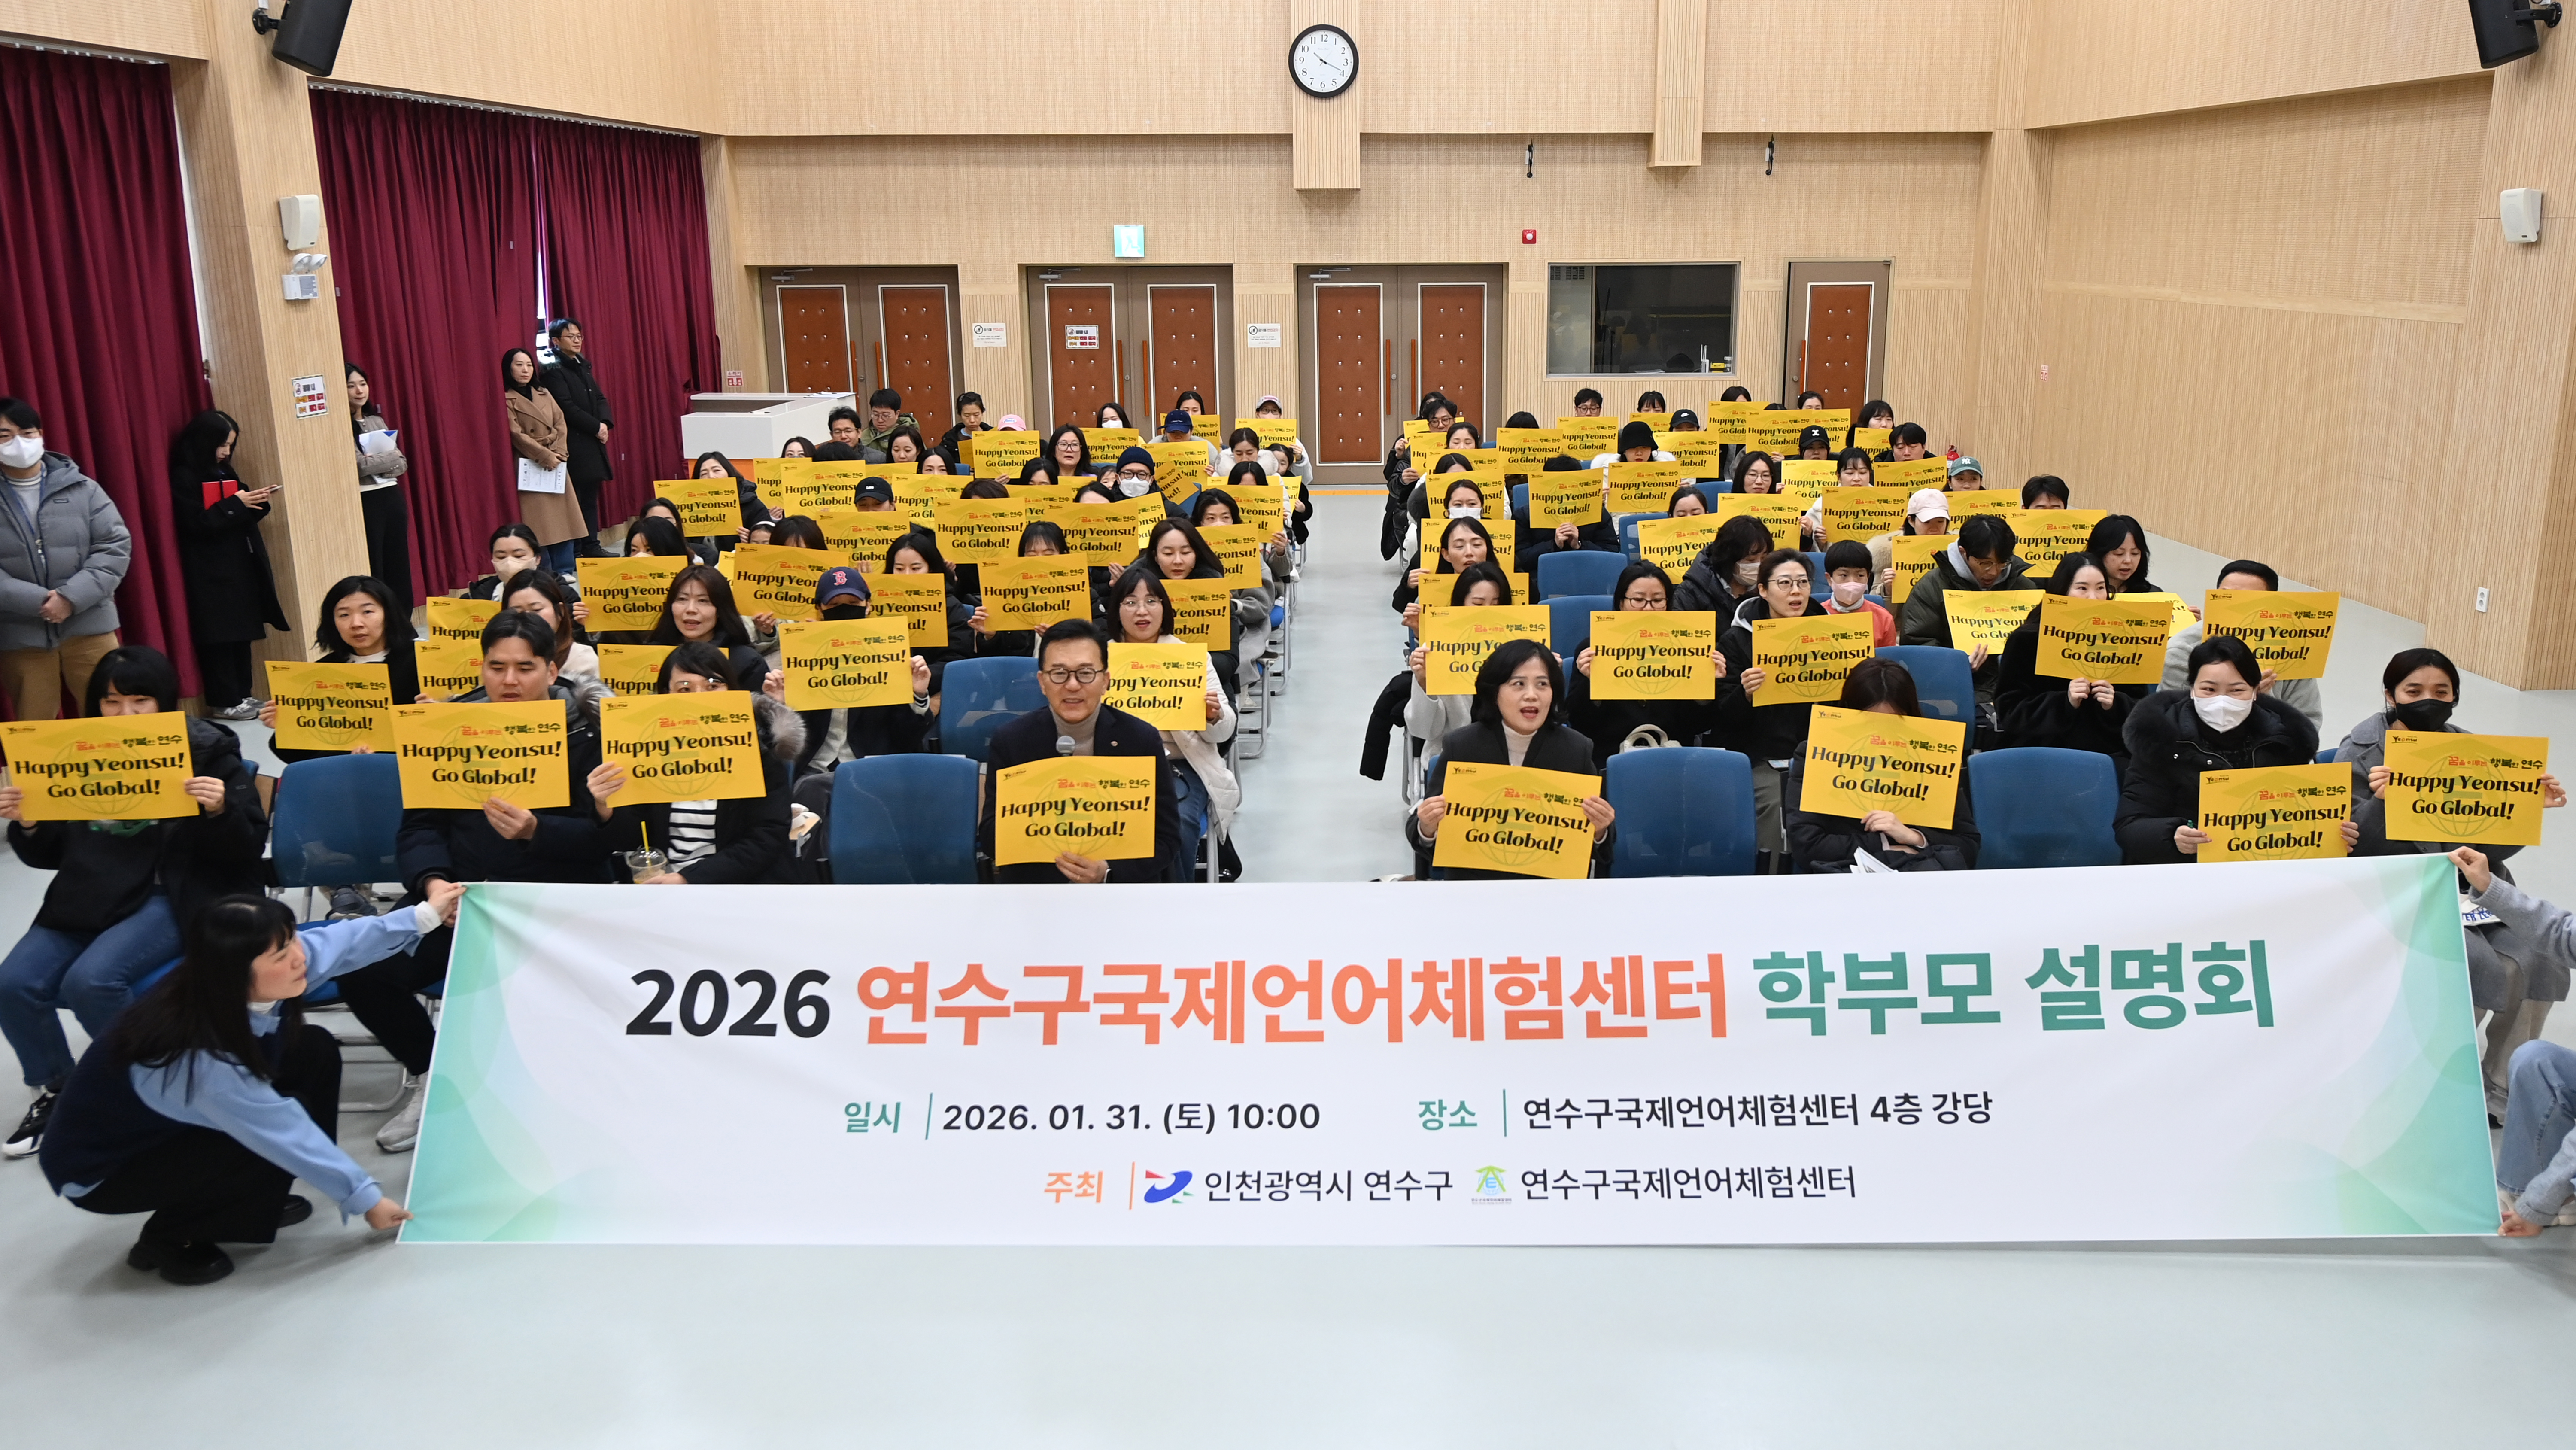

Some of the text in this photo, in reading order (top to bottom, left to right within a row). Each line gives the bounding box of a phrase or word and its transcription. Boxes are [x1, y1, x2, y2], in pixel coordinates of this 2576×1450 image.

[975, 449, 1002, 458] Happy
[1499, 445, 1526, 455] Happy
[785, 486, 820, 495] Happy
[1610, 480, 1678, 490] Happy Yeonsu!
[799, 496, 852, 507] Go Global!
[1634, 492, 1667, 500] Global!
[1824, 508, 1905, 519] Happy Yeonsu!
[938, 522, 1023, 536] Happy Yeonsu!
[1852, 522, 1891, 531] Global!
[952, 538, 1010, 549] Go Global!
[832, 571, 848, 586] B
[984, 581, 1085, 599] Happy Yeonsu!
[1002, 599, 1070, 613] Go Global!
[2317, 611, 2333, 619] 연수
[1854, 631, 1870, 639] 연수
[2044, 625, 2165, 647] Happy Yeonsu!
[2207, 623, 2331, 641] Happy Yeonsu!
[787, 649, 906, 671] Happy Yeonsu!
[1594, 644, 1711, 661] Happy Yeonsu!
[1757, 645, 1871, 668] Happy Yeonsu!
[2061, 648, 2143, 666] Go Global!
[2254, 646, 2310, 660] Global!
[808, 671, 888, 688] Go Global!
[1613, 665, 1692, 679] Go Global!
[1775, 672, 1795, 684] Go
[1140, 675, 1203, 689] Yeonsu!
[275, 694, 388, 711] Happy Yeonsu!
[1126, 696, 1183, 710] Global!
[296, 716, 372, 731] Go Global!
[729, 714, 750, 723] 연수
[537, 723, 561, 733] 연수
[157, 735, 182, 745] 연수
[607, 731, 752, 758] Happy Yeonsu!
[402, 741, 561, 763] Happy Yeonsu!
[1937, 743, 1957, 754] 연수
[15, 752, 184, 778] Happy Yeonsu!
[632, 757, 732, 778] Go Global!
[1812, 747, 1956, 778] Happy Yeonsu!
[2490, 758, 2519, 768] 행복한
[2521, 760, 2543, 770] 연수
[432, 767, 536, 785] Go Global!
[1129, 779, 1150, 789] 연수
[2389, 772, 2542, 795] Happy Yeonsu!
[47, 779, 160, 798] Go Global!
[1832, 775, 1929, 801] Go Global!
[2297, 787, 2324, 798] 행복한
[2326, 785, 2347, 796] 연수
[1002, 796, 1150, 818] Happy Yeonsu!
[1573, 797, 1584, 807] 연
[2412, 799, 2515, 820] Go Global!
[1446, 802, 1591, 833] Happy Yeonsu!
[2204, 804, 2346, 831] Happy Yeonsu!
[1025, 821, 1125, 837] Go Global!
[1465, 829, 1563, 854] Go Global!
[2227, 830, 2323, 851] Go Global!
[626, 939, 2274, 1046] 2026 연수구국제언어체험센터 학부모 설명회
[844, 1102, 1320, 1134] 일시 2026. 01. 31. (토) 10:00
[1419, 1091, 1993, 1131] 장소 연수구국제언어체험센터 4층 강당
[1044, 1170, 1453, 1203] 주최 인천광역시 연수구
[1521, 1166, 1855, 1200] 연수구국제언어체험센터
